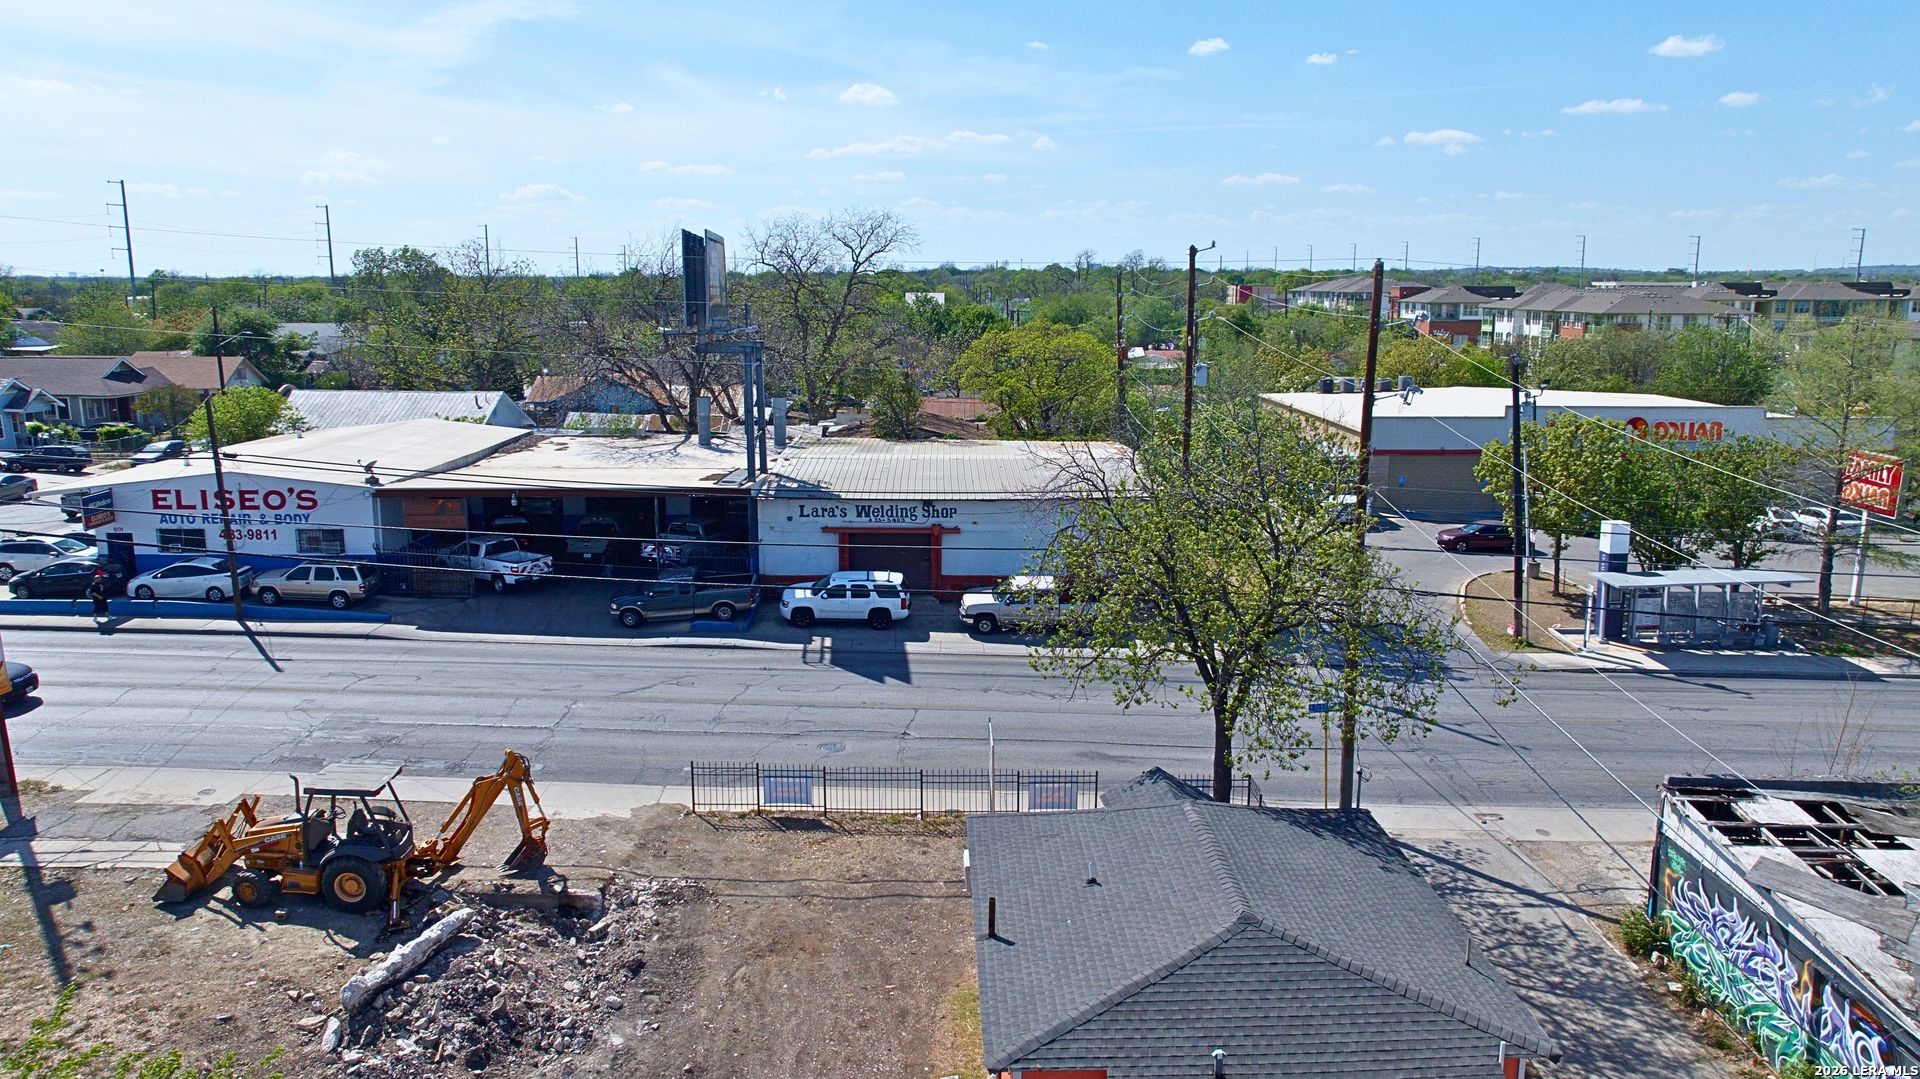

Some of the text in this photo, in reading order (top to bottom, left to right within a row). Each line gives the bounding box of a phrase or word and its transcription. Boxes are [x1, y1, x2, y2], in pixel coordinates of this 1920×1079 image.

[1652, 420, 1723, 441] DOLLAR
[151, 487, 318, 511] ELISEO'S
[160, 513, 196, 525] AUTO
[259, 513, 268, 525] &
[274, 513, 311, 525] BODY
[799, 505, 848, 518] Lara's
[855, 504, 918, 521] Welding
[513, 786, 524, 807] CASE
[264, 832, 287, 843] CASE
